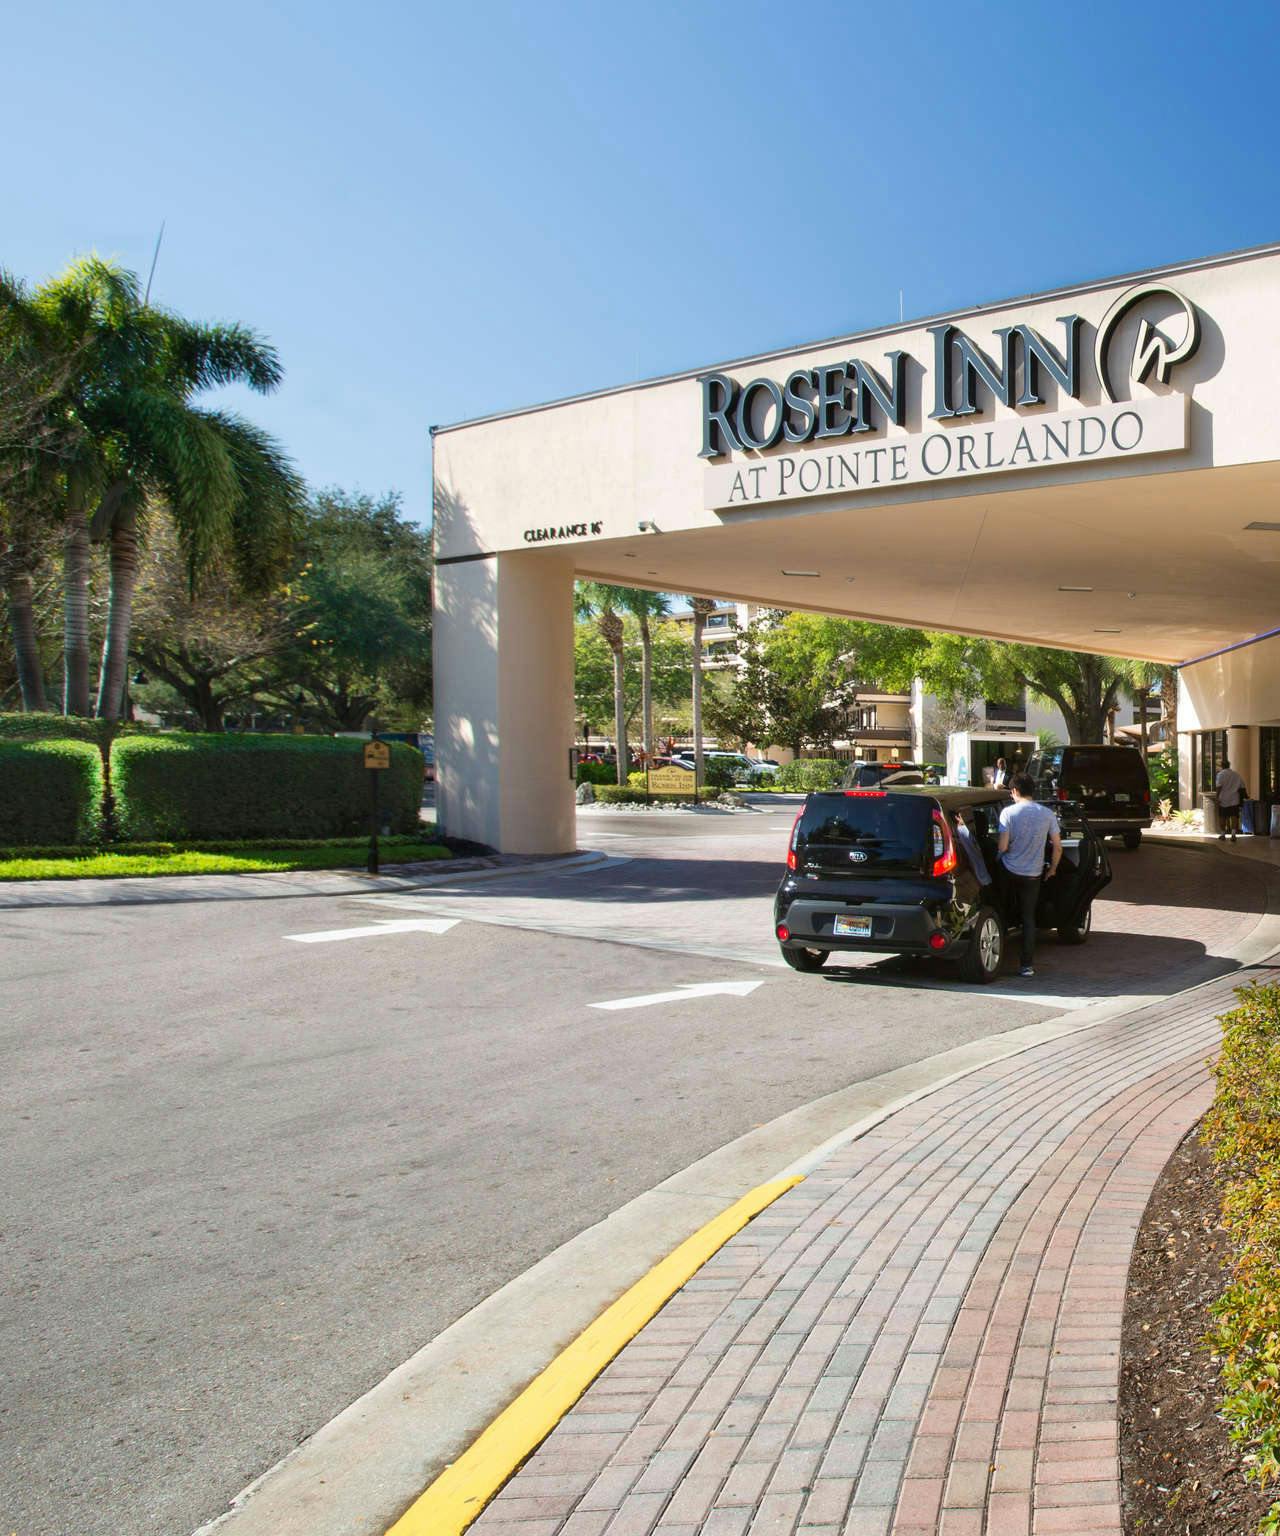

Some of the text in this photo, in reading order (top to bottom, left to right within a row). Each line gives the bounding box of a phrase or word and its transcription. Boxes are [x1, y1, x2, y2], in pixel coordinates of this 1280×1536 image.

[696, 314, 1084, 459] ROSEN INN
[728, 410, 1144, 502] AT POINTE ORLANDO
[524, 522, 588, 543] CLEARANCE
